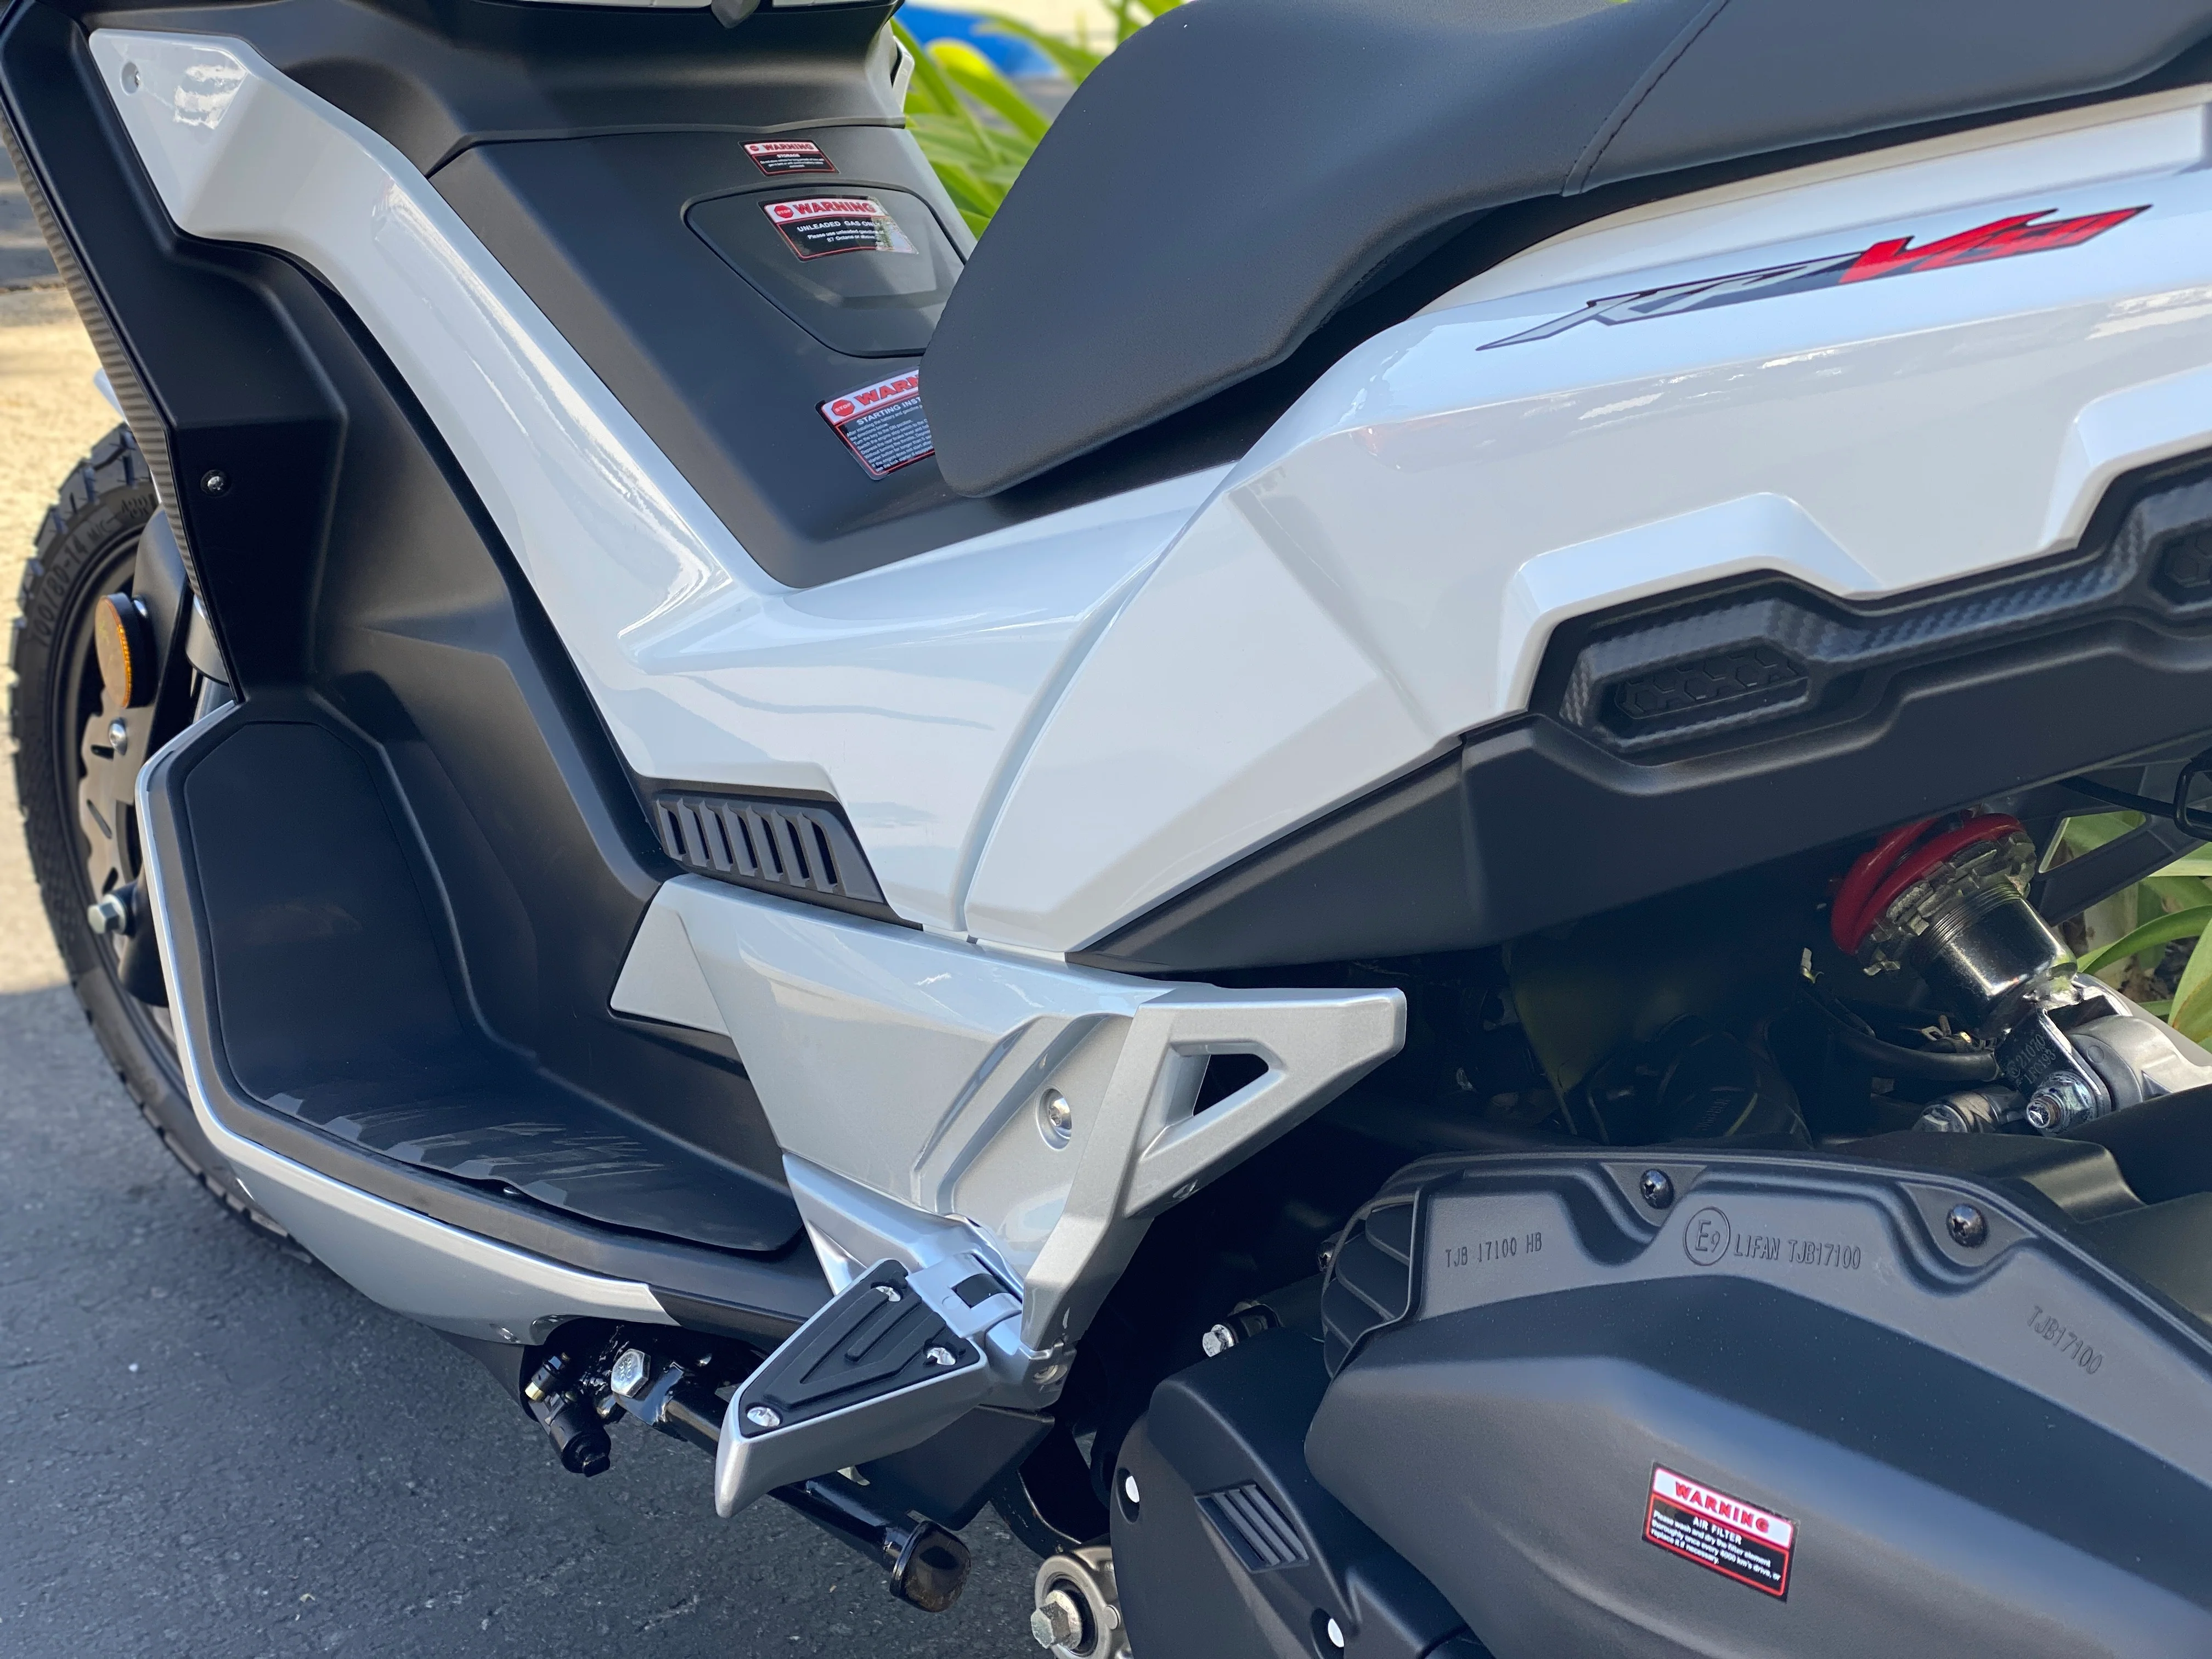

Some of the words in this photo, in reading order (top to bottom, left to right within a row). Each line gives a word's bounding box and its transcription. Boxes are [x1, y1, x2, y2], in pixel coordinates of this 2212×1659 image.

[792, 202, 876, 215] WARNING
[797, 221, 841, 232] UNLEADED
[834, 402, 851, 411] STOP
[857, 405, 901, 425] STARTING
[1445, 1246, 1468, 1267] TJB
[1477, 1237, 1517, 1262] 17100
[1526, 1232, 1542, 1254] HB
[1734, 1234, 1780, 1261] LIFAN
[1787, 1239, 1861, 1269] TJB17100
[2027, 1305, 2102, 1374] TJB17100
[1675, 1481, 1769, 1533] WARNING
[1693, 1517, 1708, 1531] AIR
[1712, 1524, 1741, 1544] FILTER
